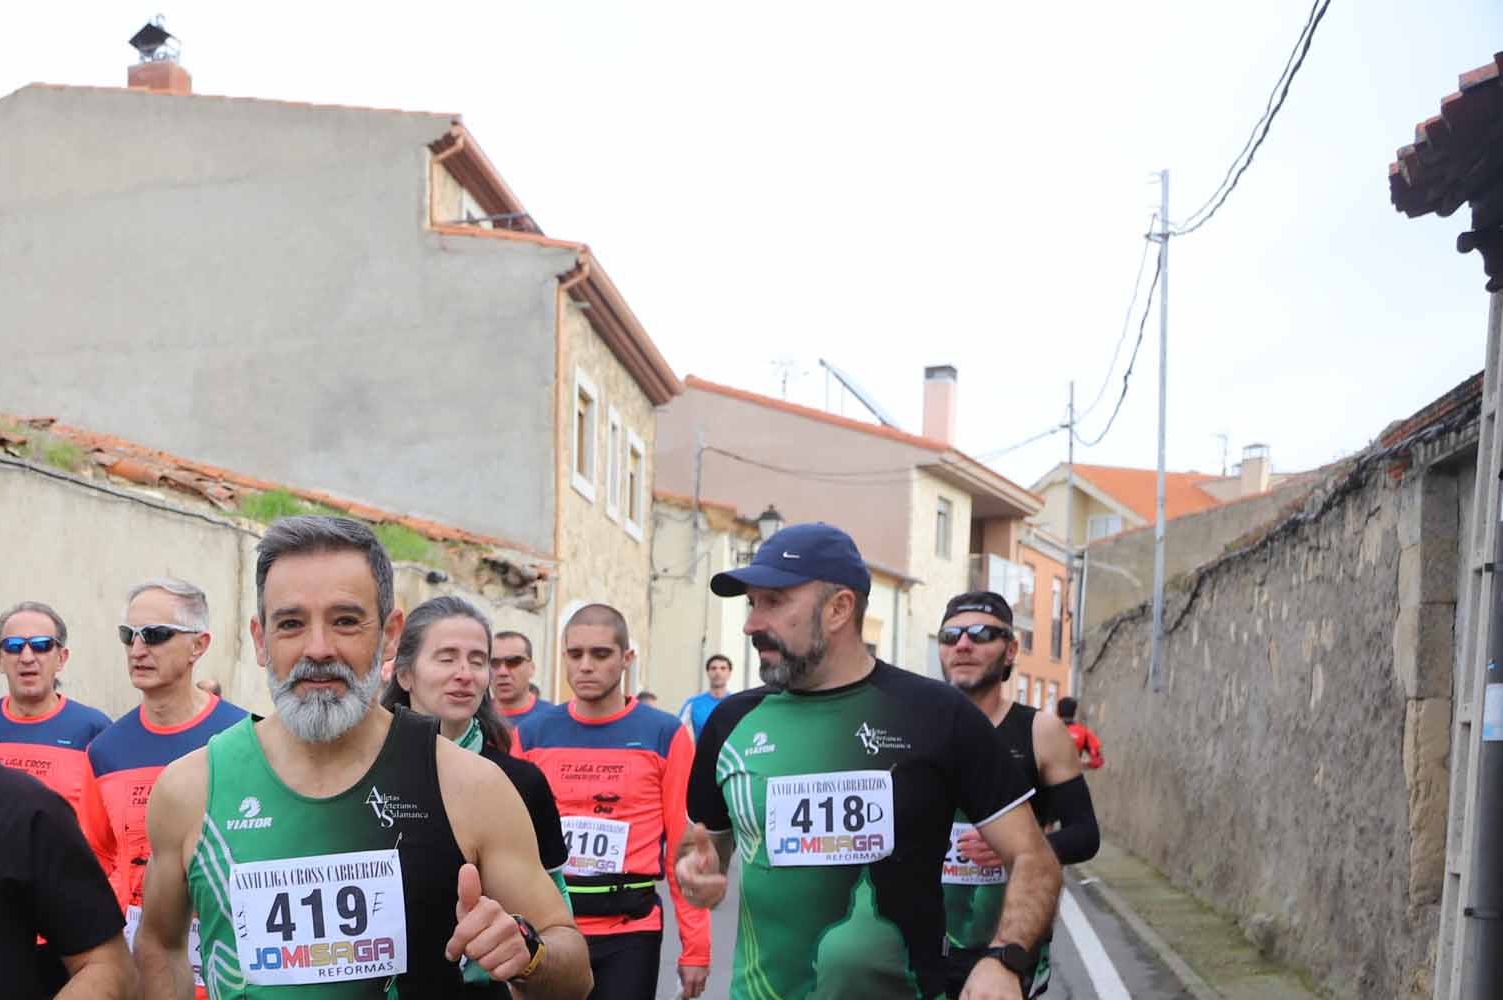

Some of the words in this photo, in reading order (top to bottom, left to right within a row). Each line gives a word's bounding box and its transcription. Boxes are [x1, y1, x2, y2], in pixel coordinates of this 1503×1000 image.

[812, 781, 837, 793] CROSS
[838, 778, 888, 792] CABRERIZOS
[226, 816, 273, 831] VIATOR
[381, 809, 429, 828] Salamanca
[791, 795, 865, 834] 418
[563, 831, 609, 857] 410
[774, 834, 885, 855] JOMISAGA
[826, 853, 885, 862] REFORMAS
[263, 869, 288, 888] LIGA
[290, 866, 324, 887] CROSS
[327, 860, 395, 883] CABRERIZOS
[266, 885, 368, 942] 419
[249, 937, 395, 971] JOMISAGA
[318, 961, 394, 978] REFORMAS
